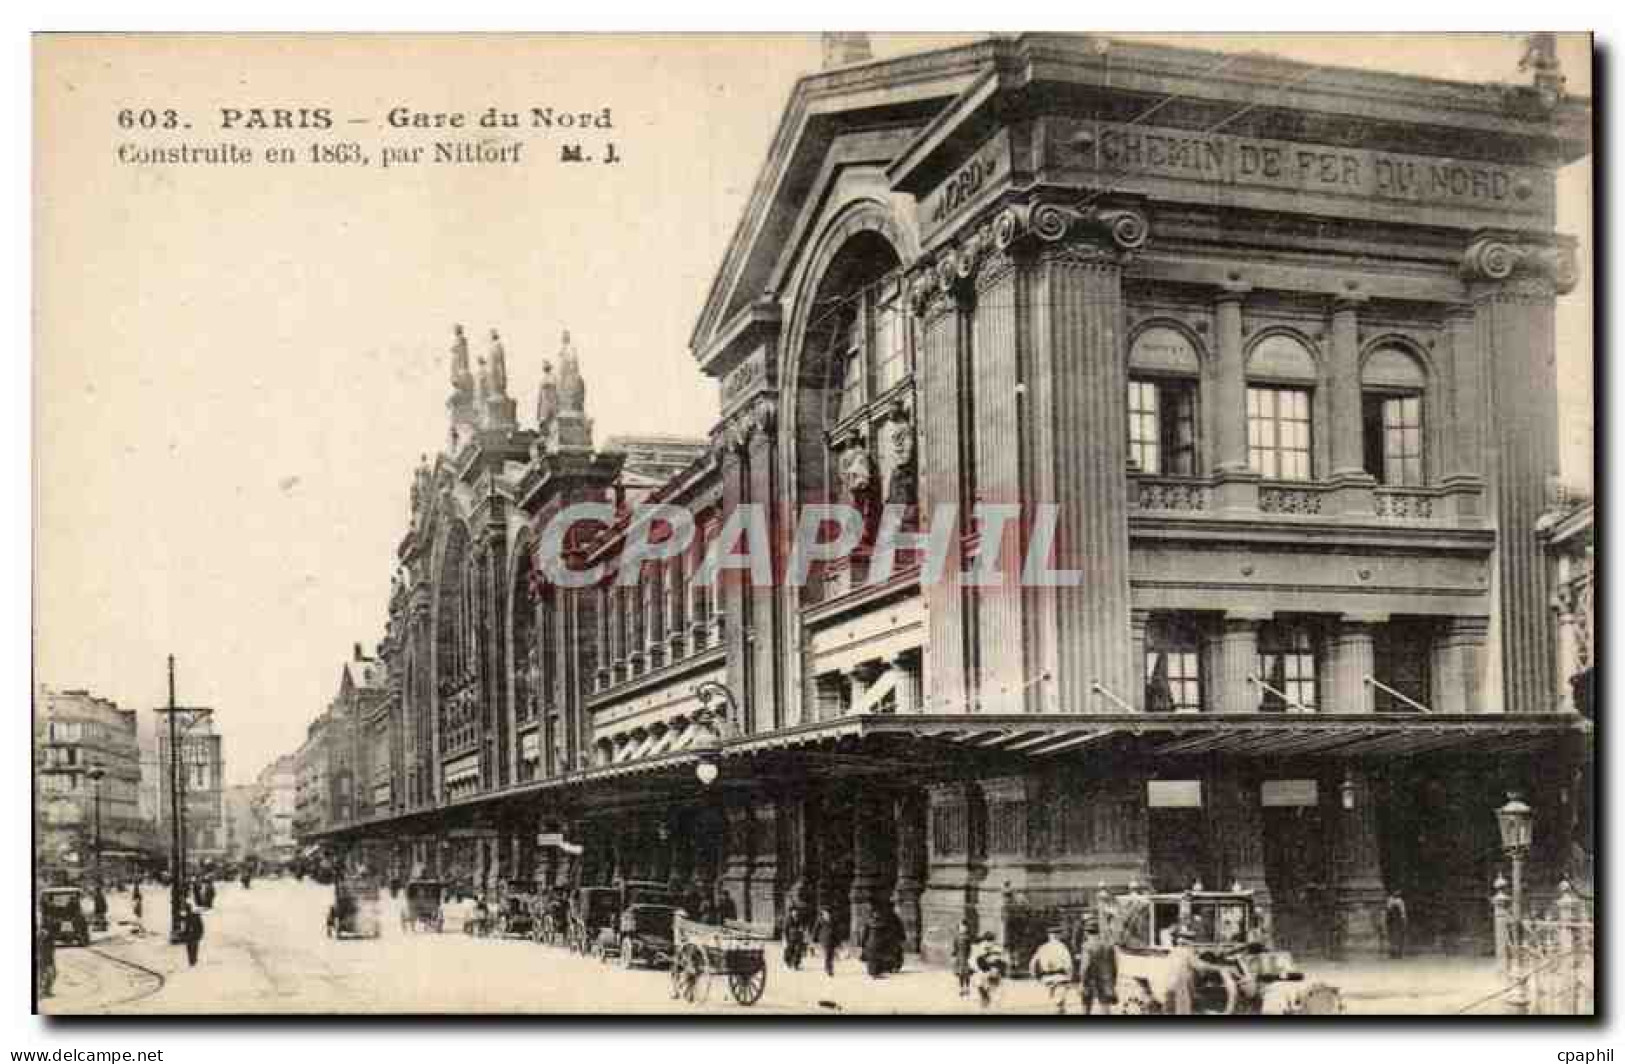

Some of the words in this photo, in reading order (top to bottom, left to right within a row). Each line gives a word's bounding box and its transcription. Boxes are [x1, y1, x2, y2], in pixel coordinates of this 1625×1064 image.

[1102, 130, 1224, 168] CHEMIN
[1240, 145, 1280, 178] DE
[1298, 152, 1361, 185] FER
[1376, 158, 1415, 190] DU
[1431, 165, 1509, 199] NORD
